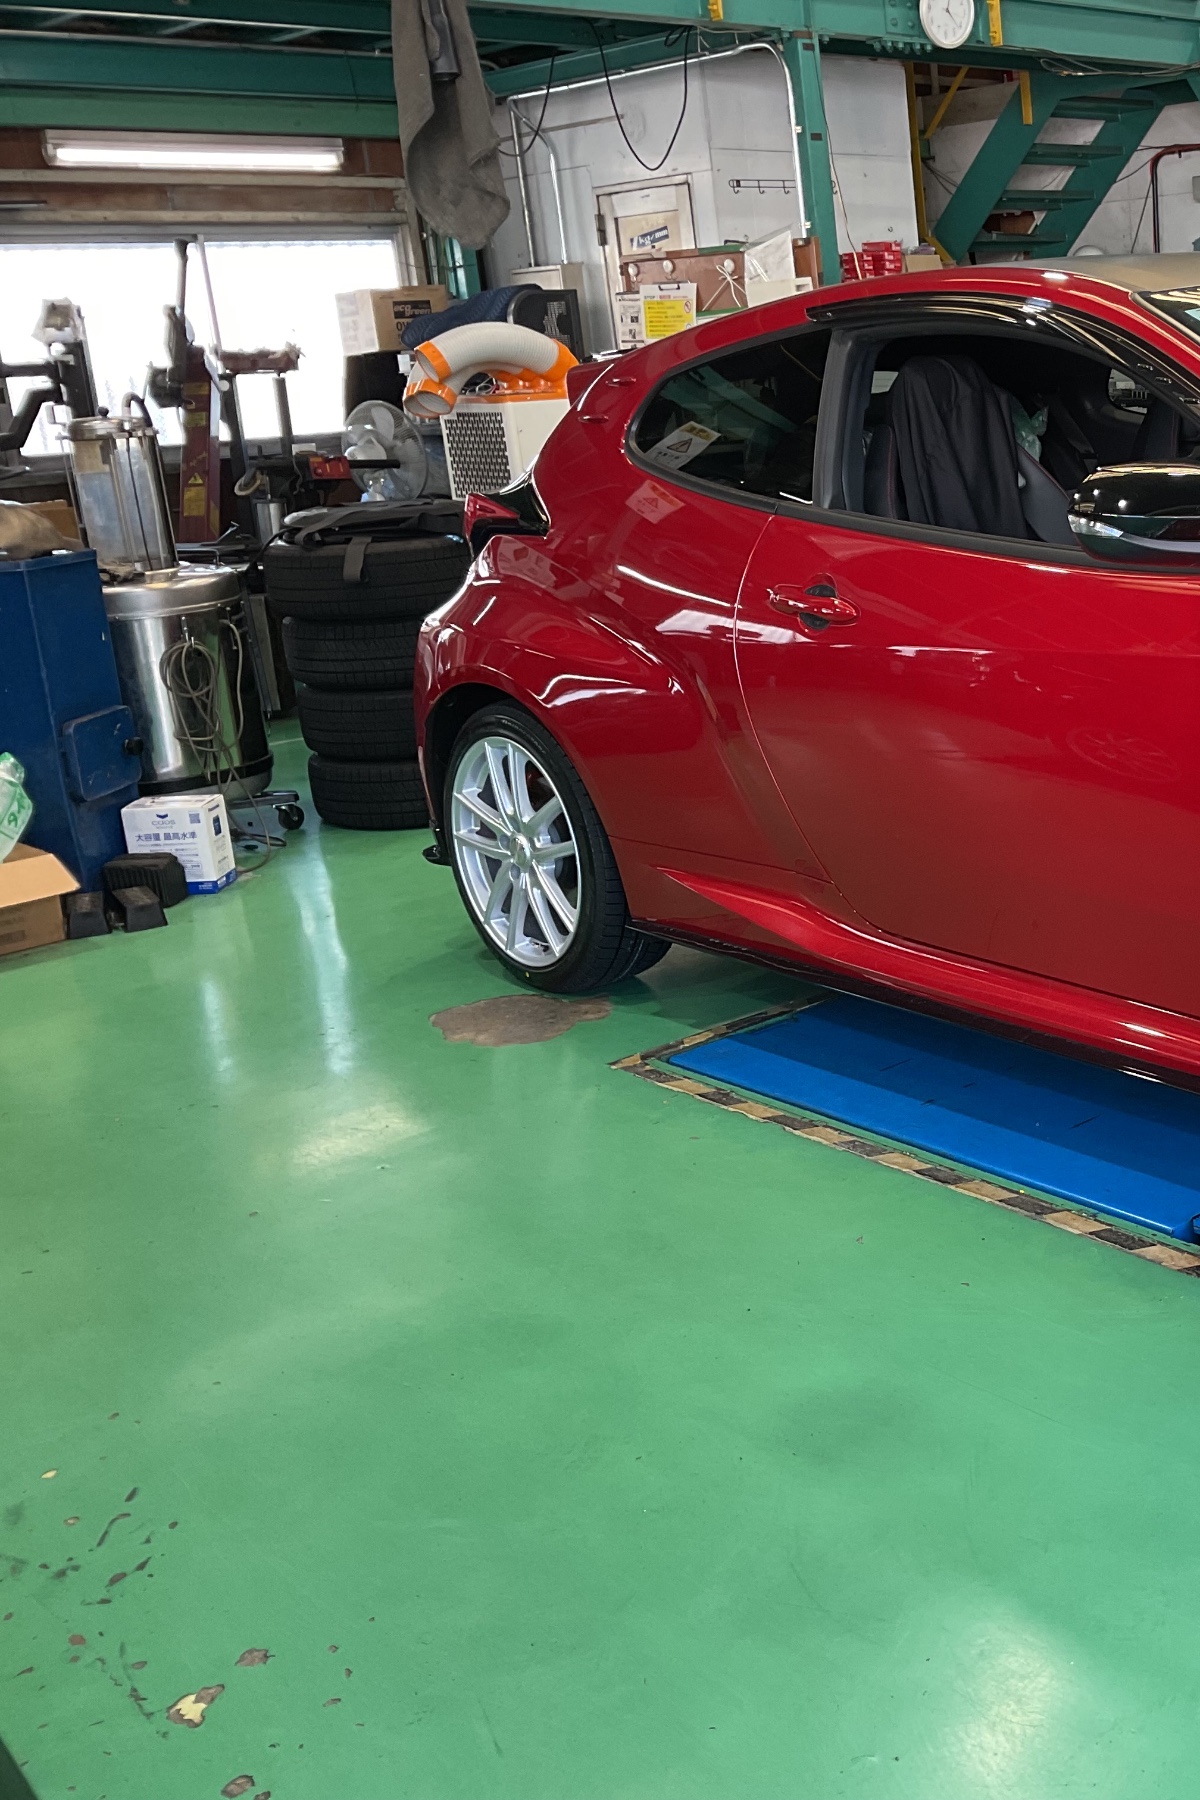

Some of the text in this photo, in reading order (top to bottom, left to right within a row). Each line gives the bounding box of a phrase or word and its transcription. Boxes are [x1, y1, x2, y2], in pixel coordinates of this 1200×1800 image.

[135, 831, 198, 842] 大容量 最高水準
